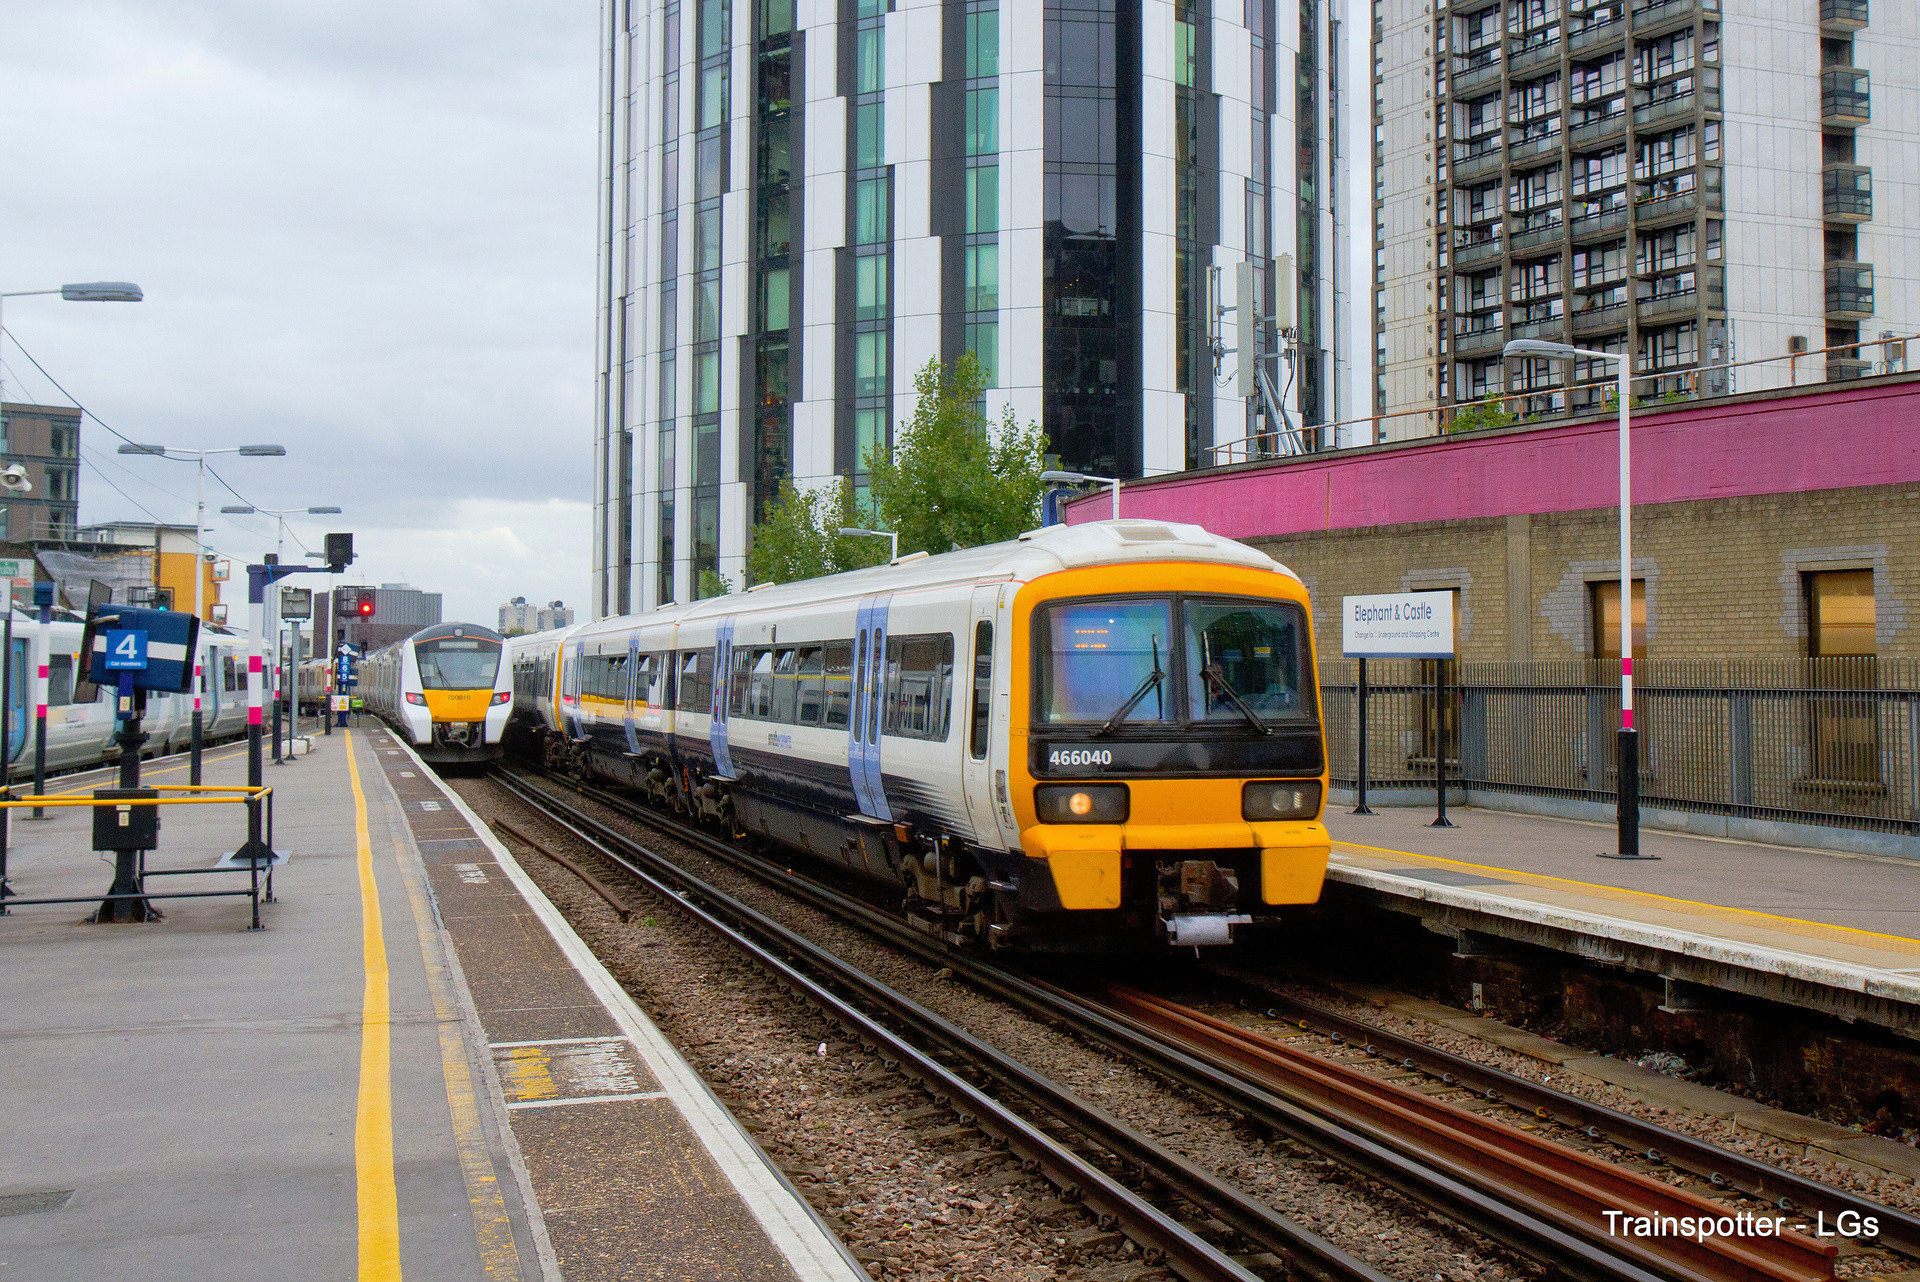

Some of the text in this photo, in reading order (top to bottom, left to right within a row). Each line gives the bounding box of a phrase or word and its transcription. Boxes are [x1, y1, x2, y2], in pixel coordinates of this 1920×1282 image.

[1355, 602, 1432, 625] Elephant & Castle
[1355, 631, 1369, 639] Change
[1378, 631, 1400, 639] Underground
[1409, 630, 1426, 639] Shopping
[1427, 629, 1440, 638] Centre
[115, 634, 137, 659] 4
[1049, 750, 1112, 765] 466040
